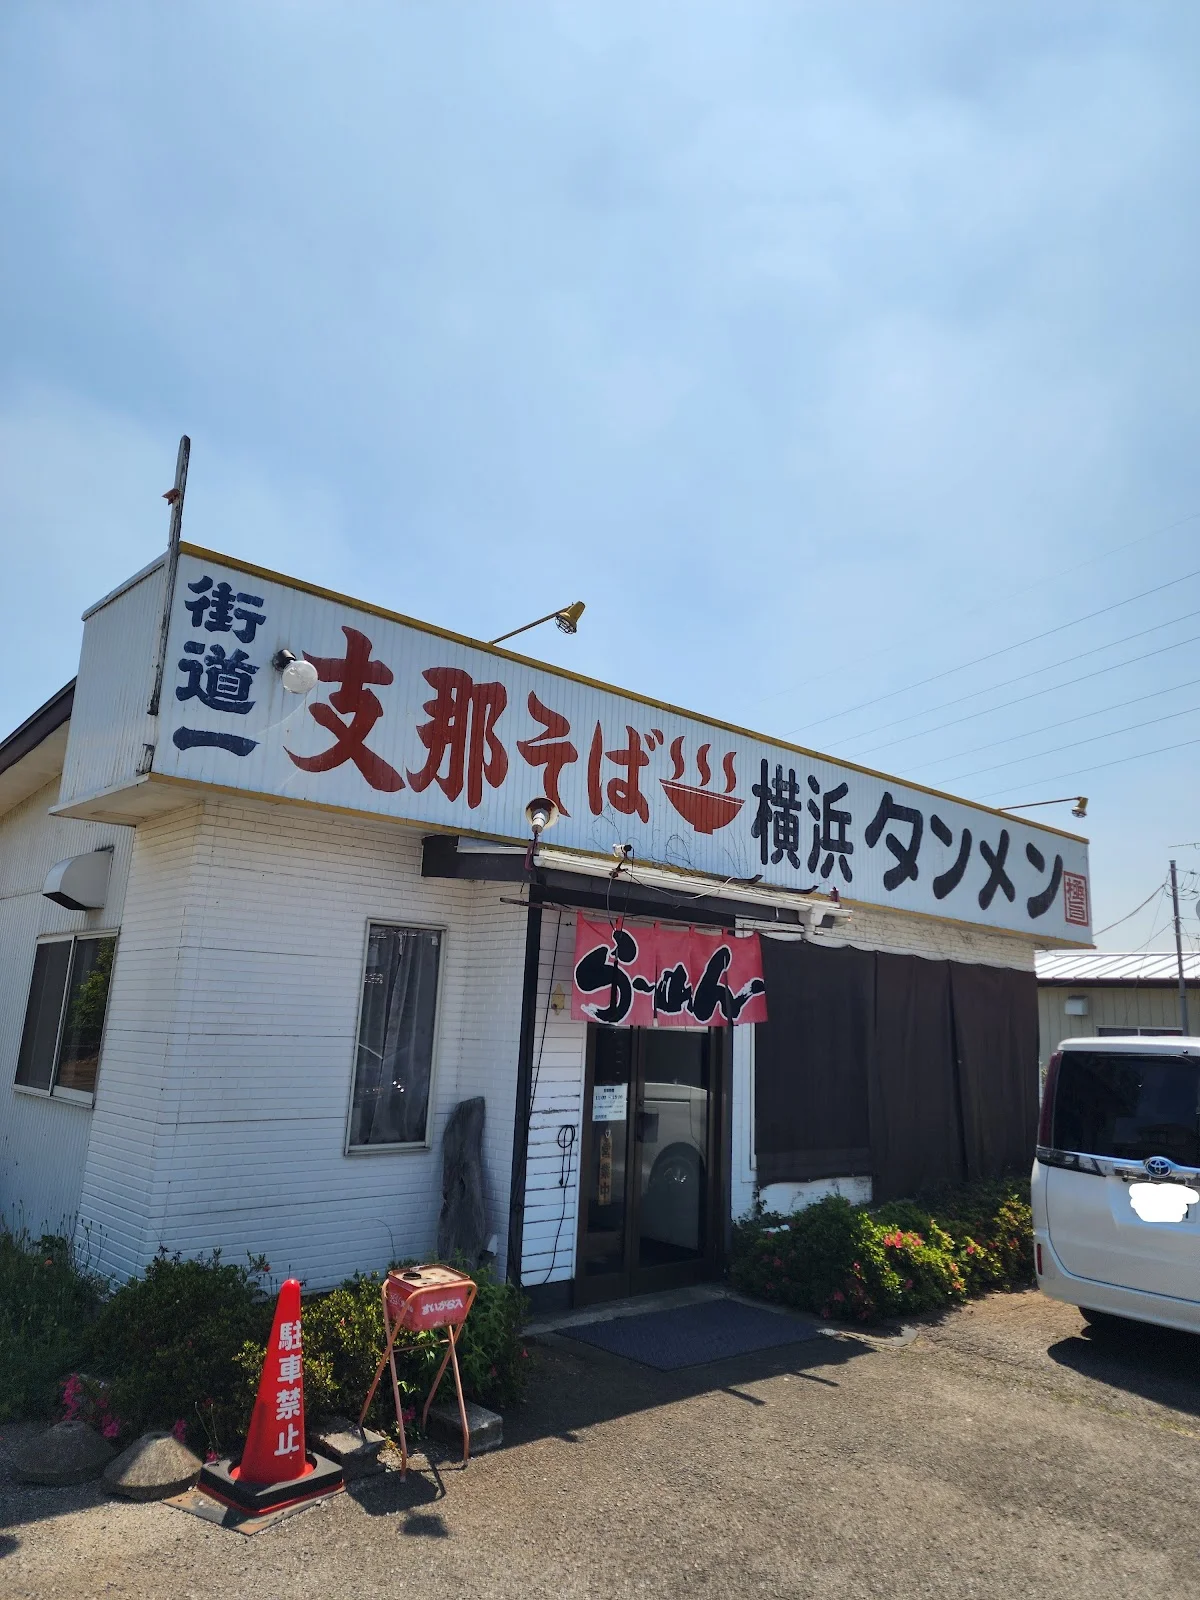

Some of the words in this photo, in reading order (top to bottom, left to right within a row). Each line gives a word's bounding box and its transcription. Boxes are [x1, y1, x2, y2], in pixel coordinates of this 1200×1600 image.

[173, 575, 266, 757] 街道一
[283, 625, 663, 825] 支那そば
[750, 758, 1063, 920] 横浜タンメン
[574, 927, 766, 1025] らーめん
[273, 1319, 303, 1457] 駐車禁止
